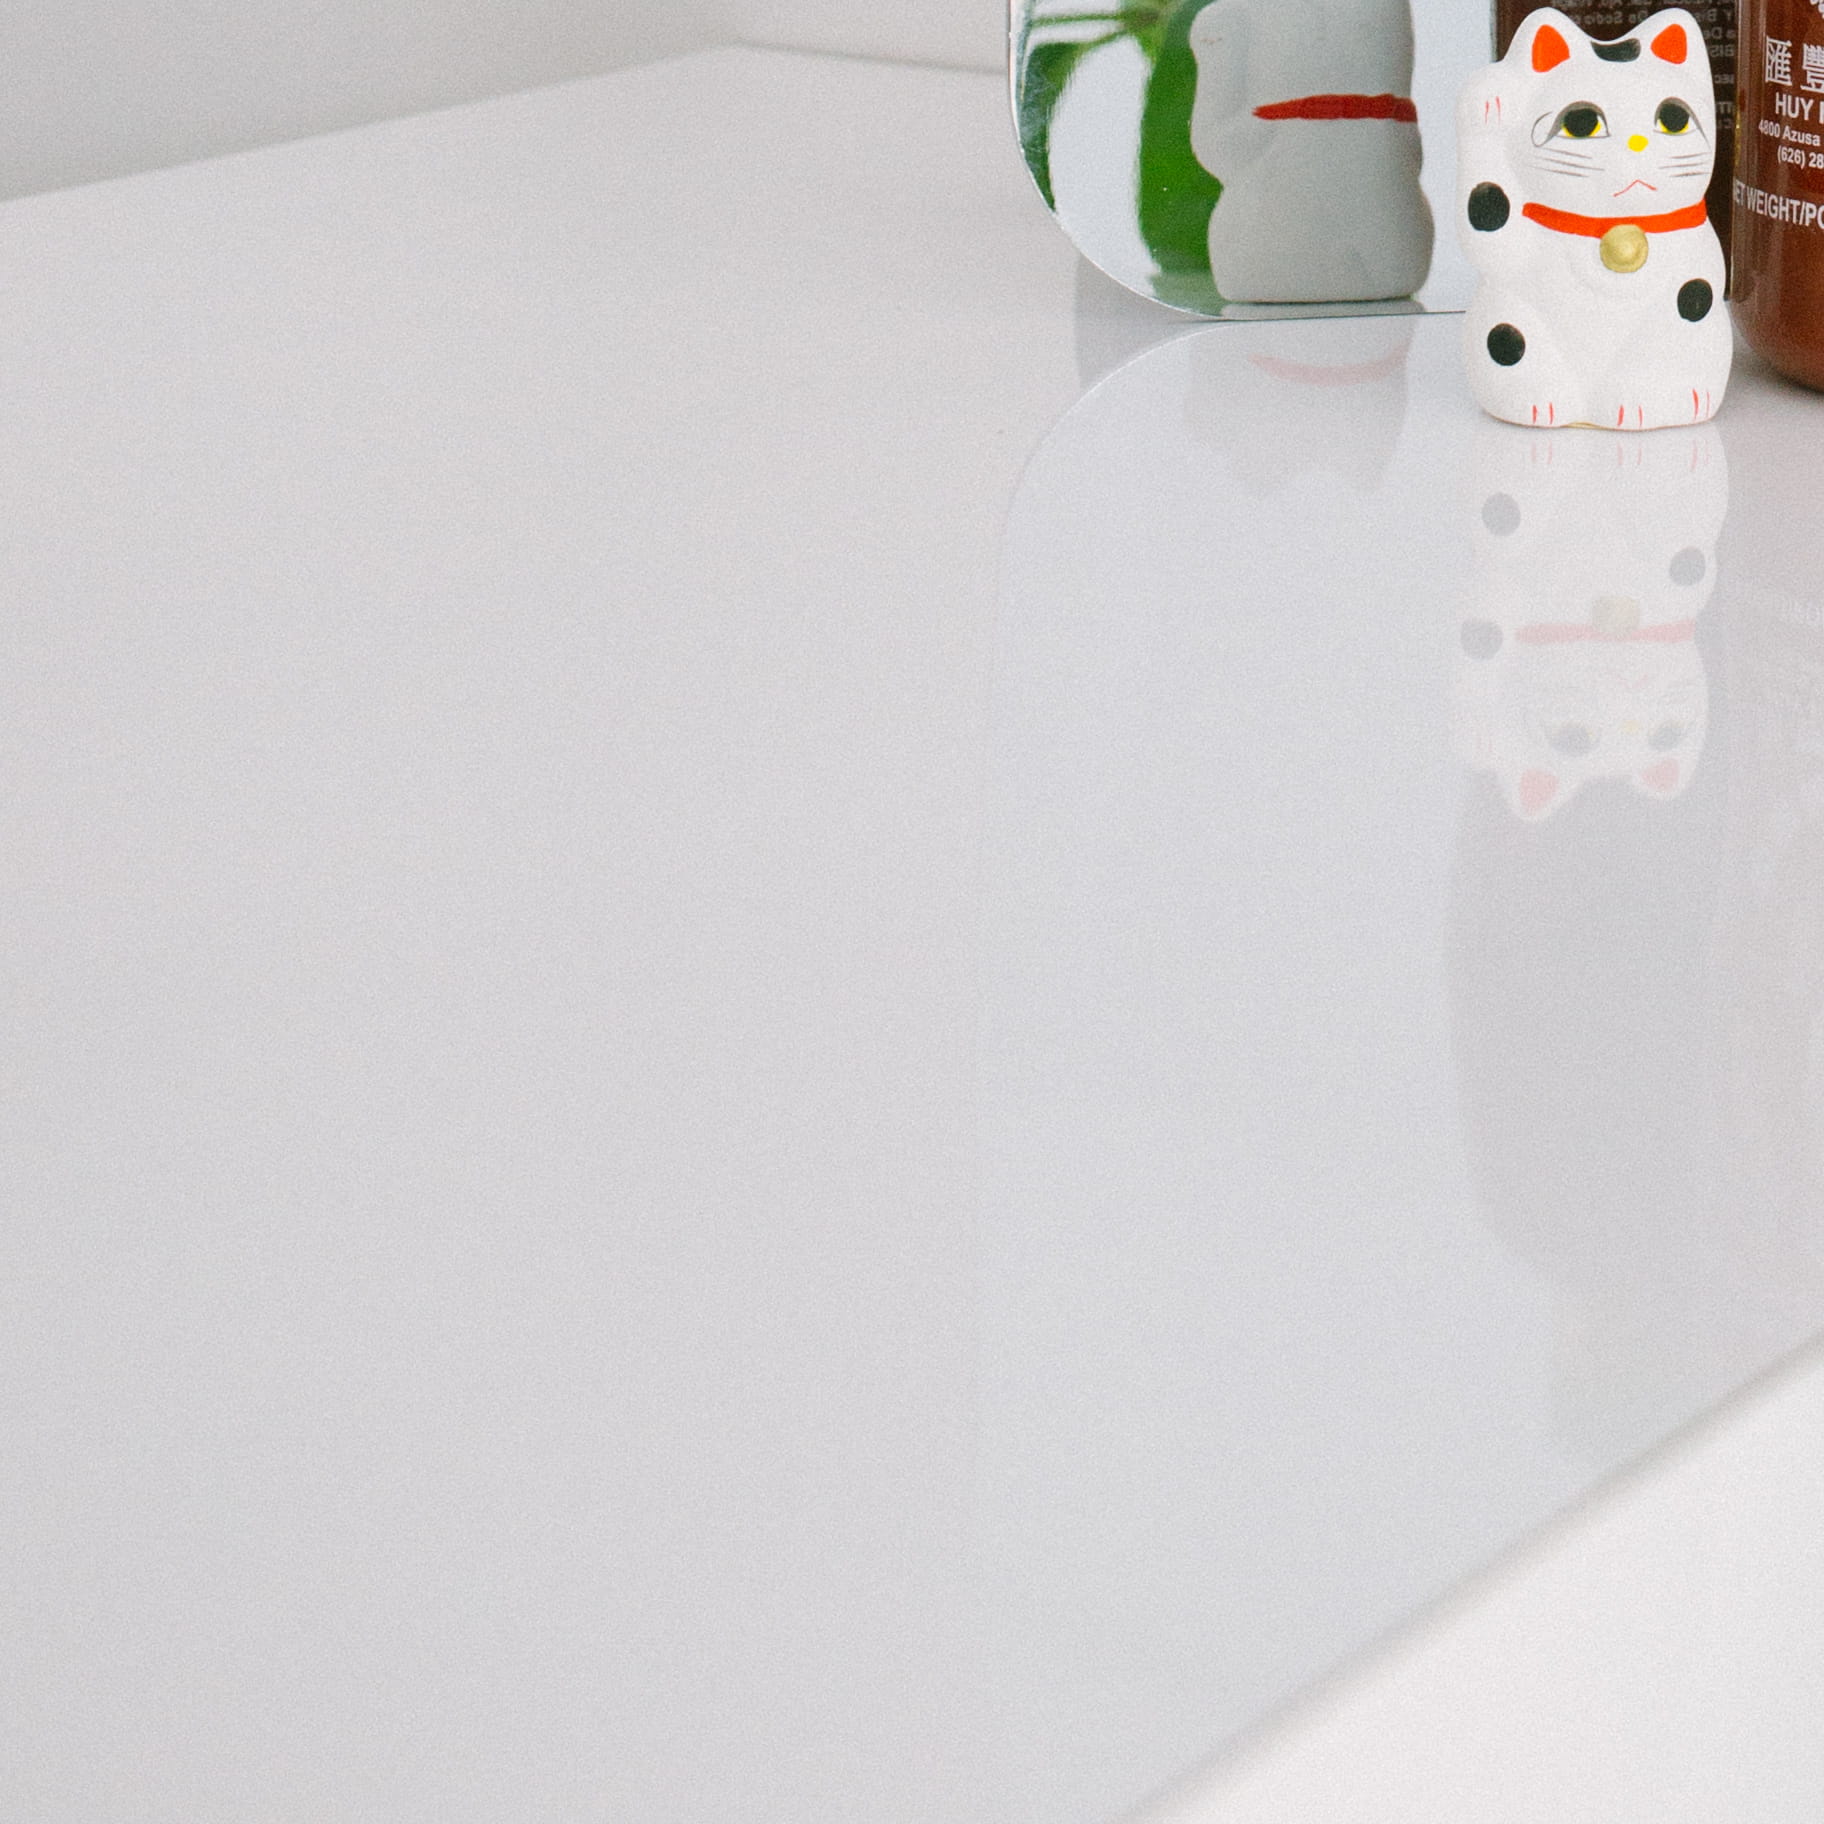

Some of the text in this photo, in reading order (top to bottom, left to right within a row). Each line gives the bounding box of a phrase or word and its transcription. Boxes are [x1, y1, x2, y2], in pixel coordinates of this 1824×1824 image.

[1775, 92, 1815, 121] HUY
[1758, 119, 1781, 139] 4800
[1782, 125, 1820, 148] Azusa
[1777, 145, 1806, 170] (626)
[1733, 179, 1746, 206] ET
